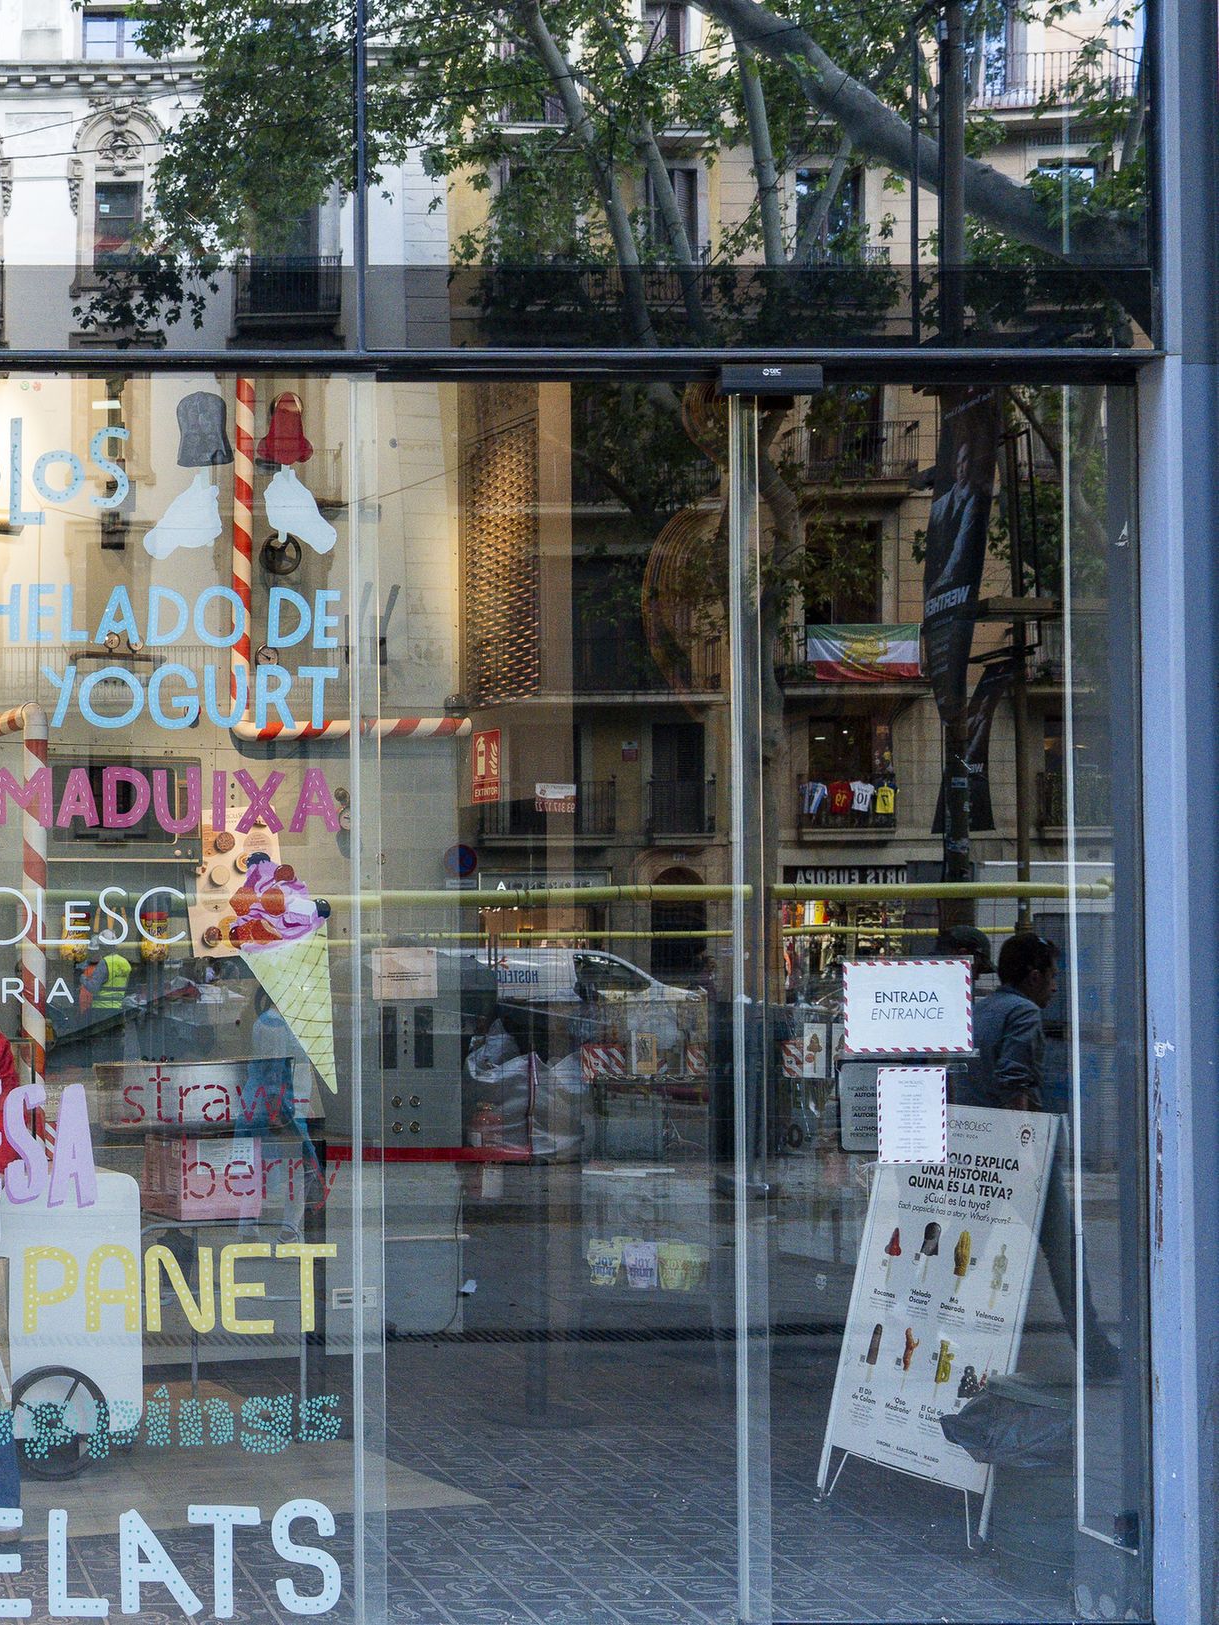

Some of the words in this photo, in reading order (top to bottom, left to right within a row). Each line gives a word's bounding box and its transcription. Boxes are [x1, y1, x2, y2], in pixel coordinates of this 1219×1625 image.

[267, 588, 340, 649] DE
[41, 662, 340, 730] YOGURT
[474, 786, 498, 798] EXTINTOR
[875, 991, 939, 1004] ENTRADA
[871, 1007, 945, 1021] ENTRANCE
[121, 1065, 310, 1124] straw-
[183, 1133, 342, 1213] berry
[974, 1156, 1020, 1171] EXPLICA
[921, 1165, 946, 1177] UNA
[948, 1167, 1003, 1184] HISTÒRIA.
[908, 1175, 944, 1191] QUINA
[947, 1181, 959, 1193] ÉS
[962, 1183, 976, 1195] LA
[979, 1185, 1013, 1200] TEVA?
[923, 1192, 947, 1205] ¿Cuál
[948, 1198, 957, 1206] es
[959, 1198, 966, 1207] la
[968, 1200, 991, 1212] tuya?
[897, 1200, 911, 1210] Each
[911, 1204, 935, 1215] popsicle
[936, 1207, 946, 1216] has
[990, 1216, 1012, 1225] yours?
[23, 1242, 338, 1335] PANET
[873, 1288, 896, 1299] Rocanas
[858, 1386, 864, 1394] El
[928, 1406, 936, 1414] Cul
